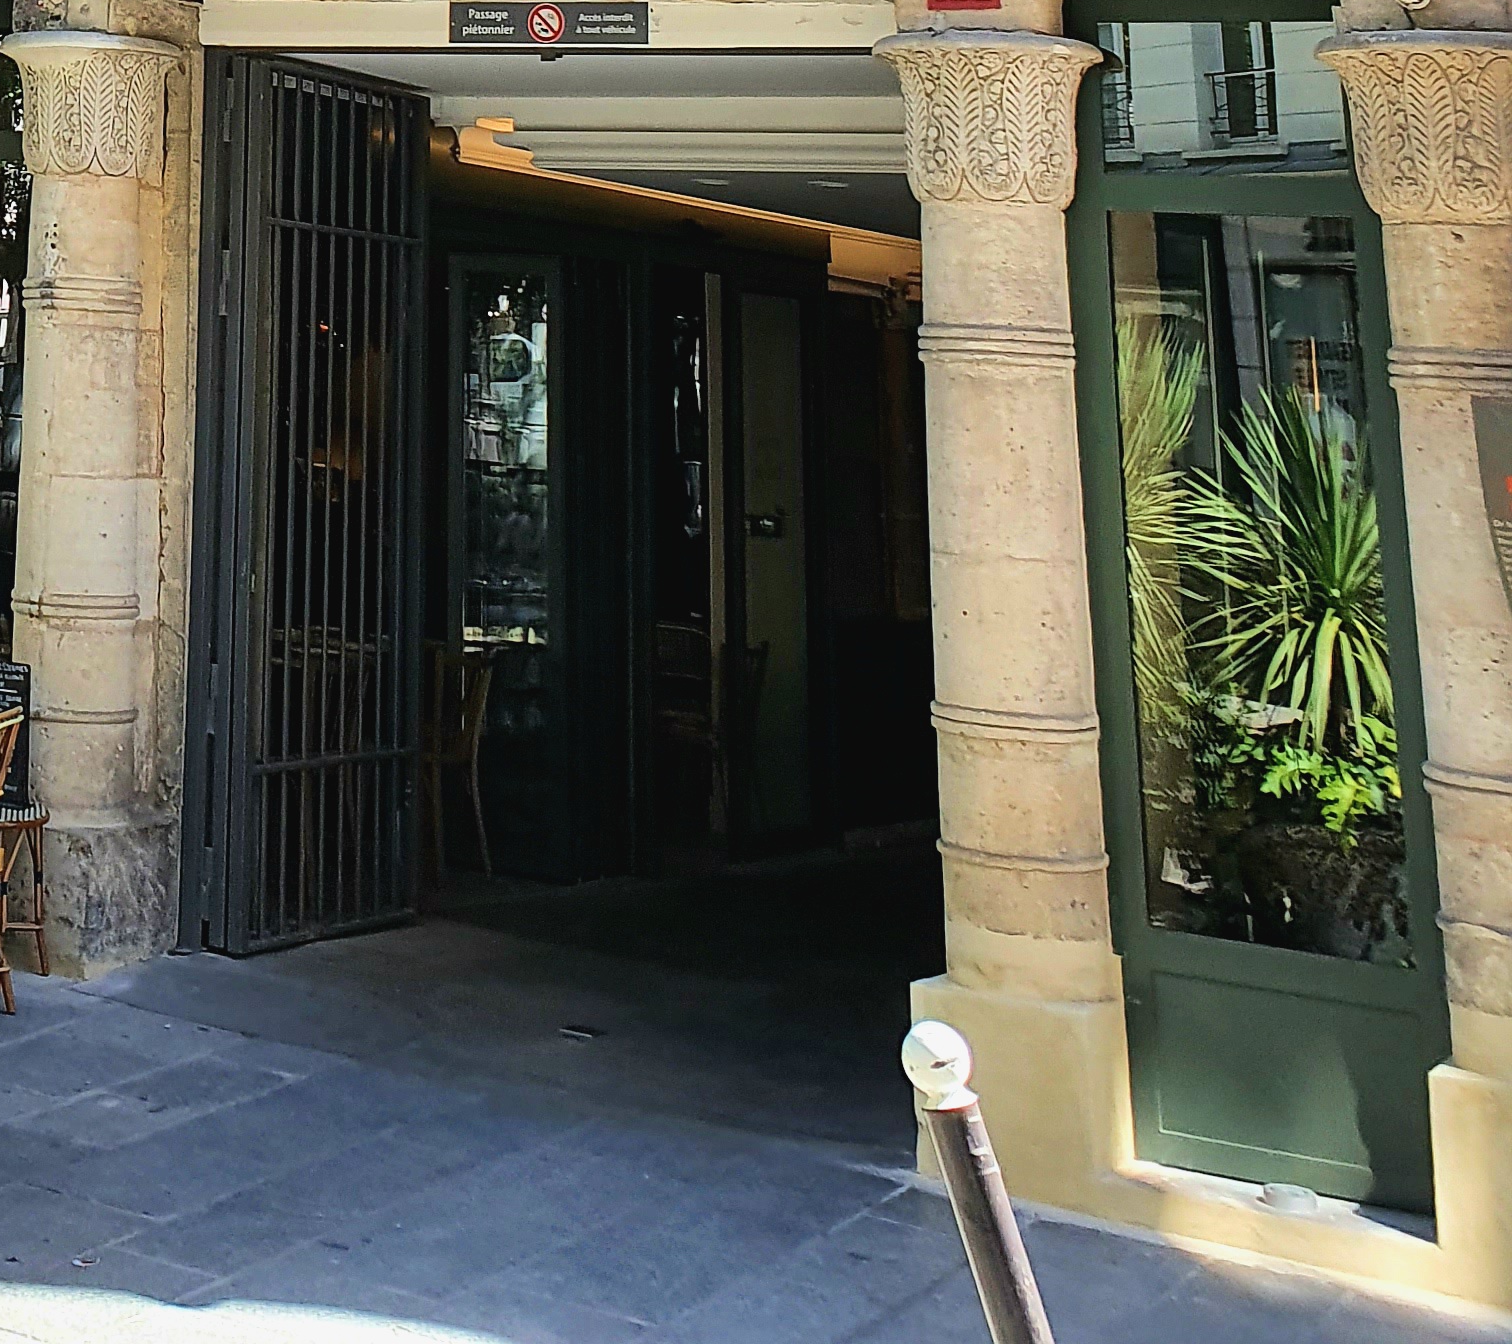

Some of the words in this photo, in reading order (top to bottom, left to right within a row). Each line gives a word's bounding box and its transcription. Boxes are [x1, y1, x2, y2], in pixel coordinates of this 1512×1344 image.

[468, 8, 509, 21] Passage
[603, 12, 635, 22] interdit
[462, 22, 515, 37] piétonnier
